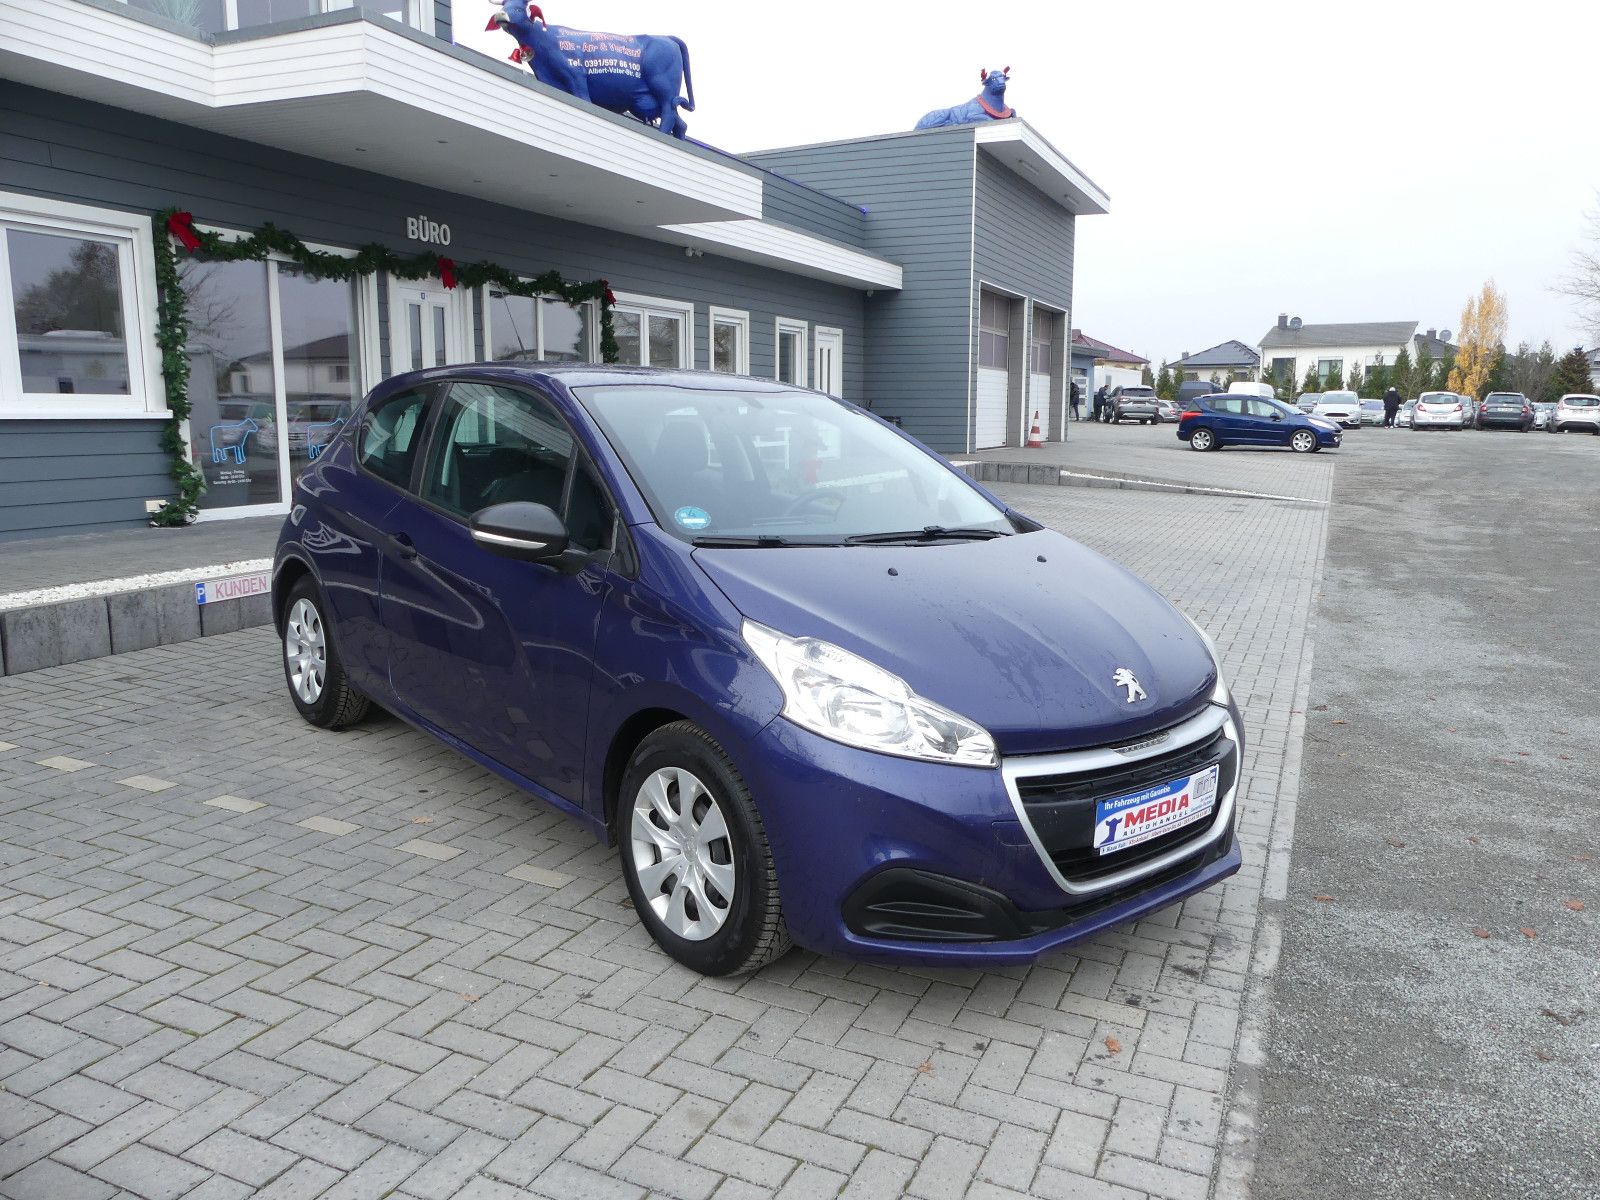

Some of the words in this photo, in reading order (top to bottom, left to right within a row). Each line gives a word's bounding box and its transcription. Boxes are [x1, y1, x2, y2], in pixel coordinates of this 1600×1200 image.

[568, 59, 582, 67] Tel.
[585, 59, 617, 67] 0391/597
[407, 215, 450, 245] BÜRO
[197, 588, 205, 599] P
[215, 576, 267, 598] KUNDEN
[1104, 801, 1113, 810] Ihr
[1114, 795, 1141, 808] Fahrzeug
[1141, 793, 1150, 801] mit
[1150, 785, 1170, 798] Garantie
[1123, 811, 1188, 837] AUTOHANDEL
[1124, 794, 1189, 829] MEDIA
